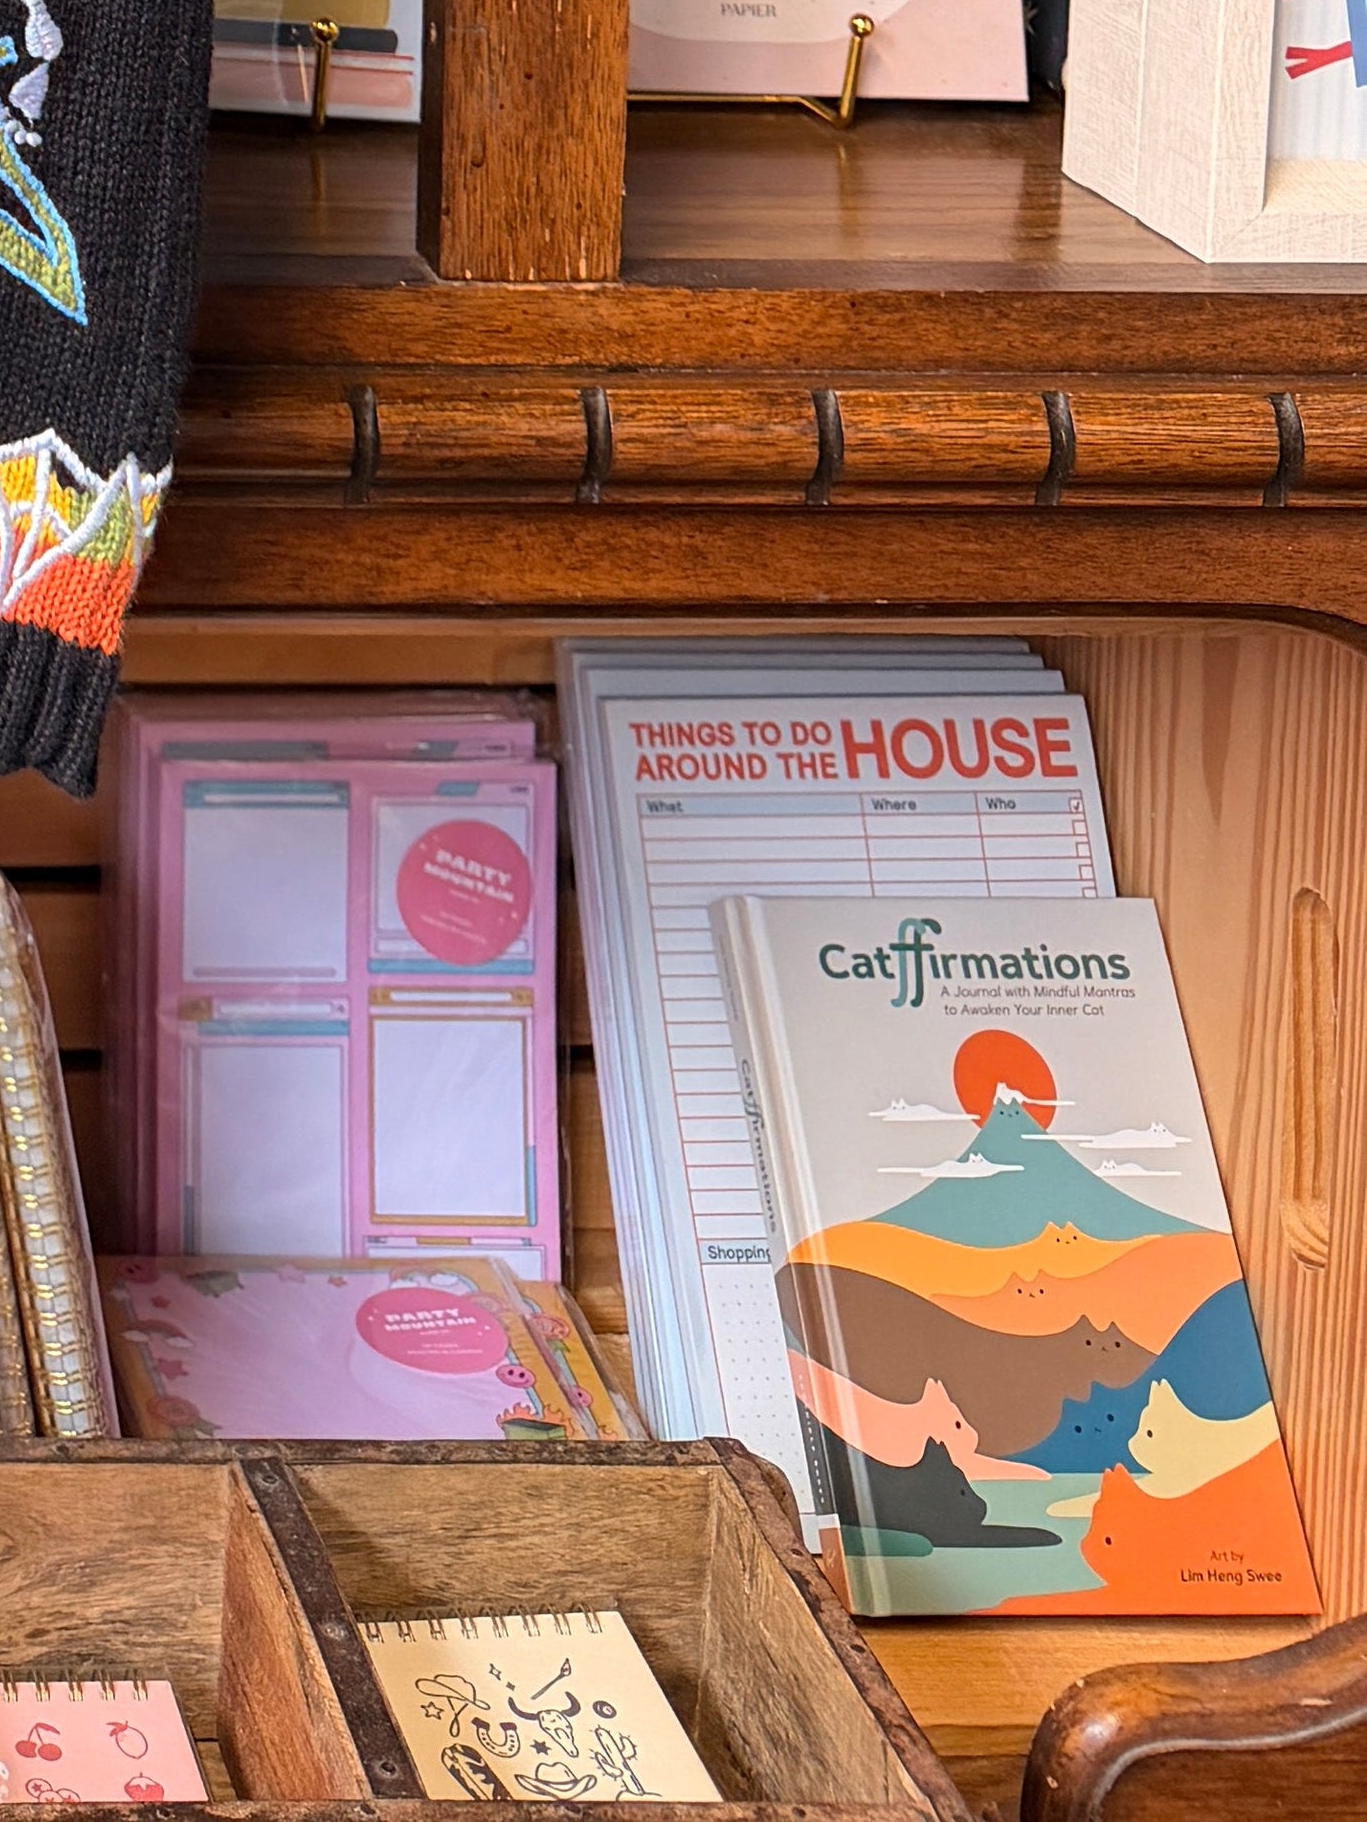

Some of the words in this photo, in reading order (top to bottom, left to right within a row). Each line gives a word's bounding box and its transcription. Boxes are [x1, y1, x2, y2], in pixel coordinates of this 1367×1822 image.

[720, 3, 777, 18] PAPIER
[629, 721, 735, 747] THINGS
[742, 722, 781, 746] TO
[792, 721, 832, 745] DO
[840, 717, 1078, 780] HOUSE
[636, 752, 768, 781] AROUND
[776, 752, 840, 780] THE
[647, 799, 683, 813] What
[872, 797, 917, 812] Where
[986, 796, 1016, 811] Who
[436, 849, 511, 887] PARTY
[819, 917, 1131, 1008] Catffirmations
[941, 986, 950, 998] A
[953, 985, 1001, 998] Journal
[1005, 985, 1031, 998] with
[1034, 984, 1080, 998] Mindful
[1084, 985, 1136, 998] Mantras
[944, 1004, 957, 1016] to
[961, 1004, 1010, 1016] Awaken
[1014, 1004, 1042, 1016] Your
[1046, 1004, 1078, 1016] Inner
[1082, 1004, 1105, 1016] Cat
[385, 1308, 459, 1322] PARTY
[1210, 1550, 1228, 1562] Art
[1180, 1569, 1204, 1583] Lim
[1207, 1568, 1244, 1586] Heng
[1246, 1568, 1282, 1582] Swee
